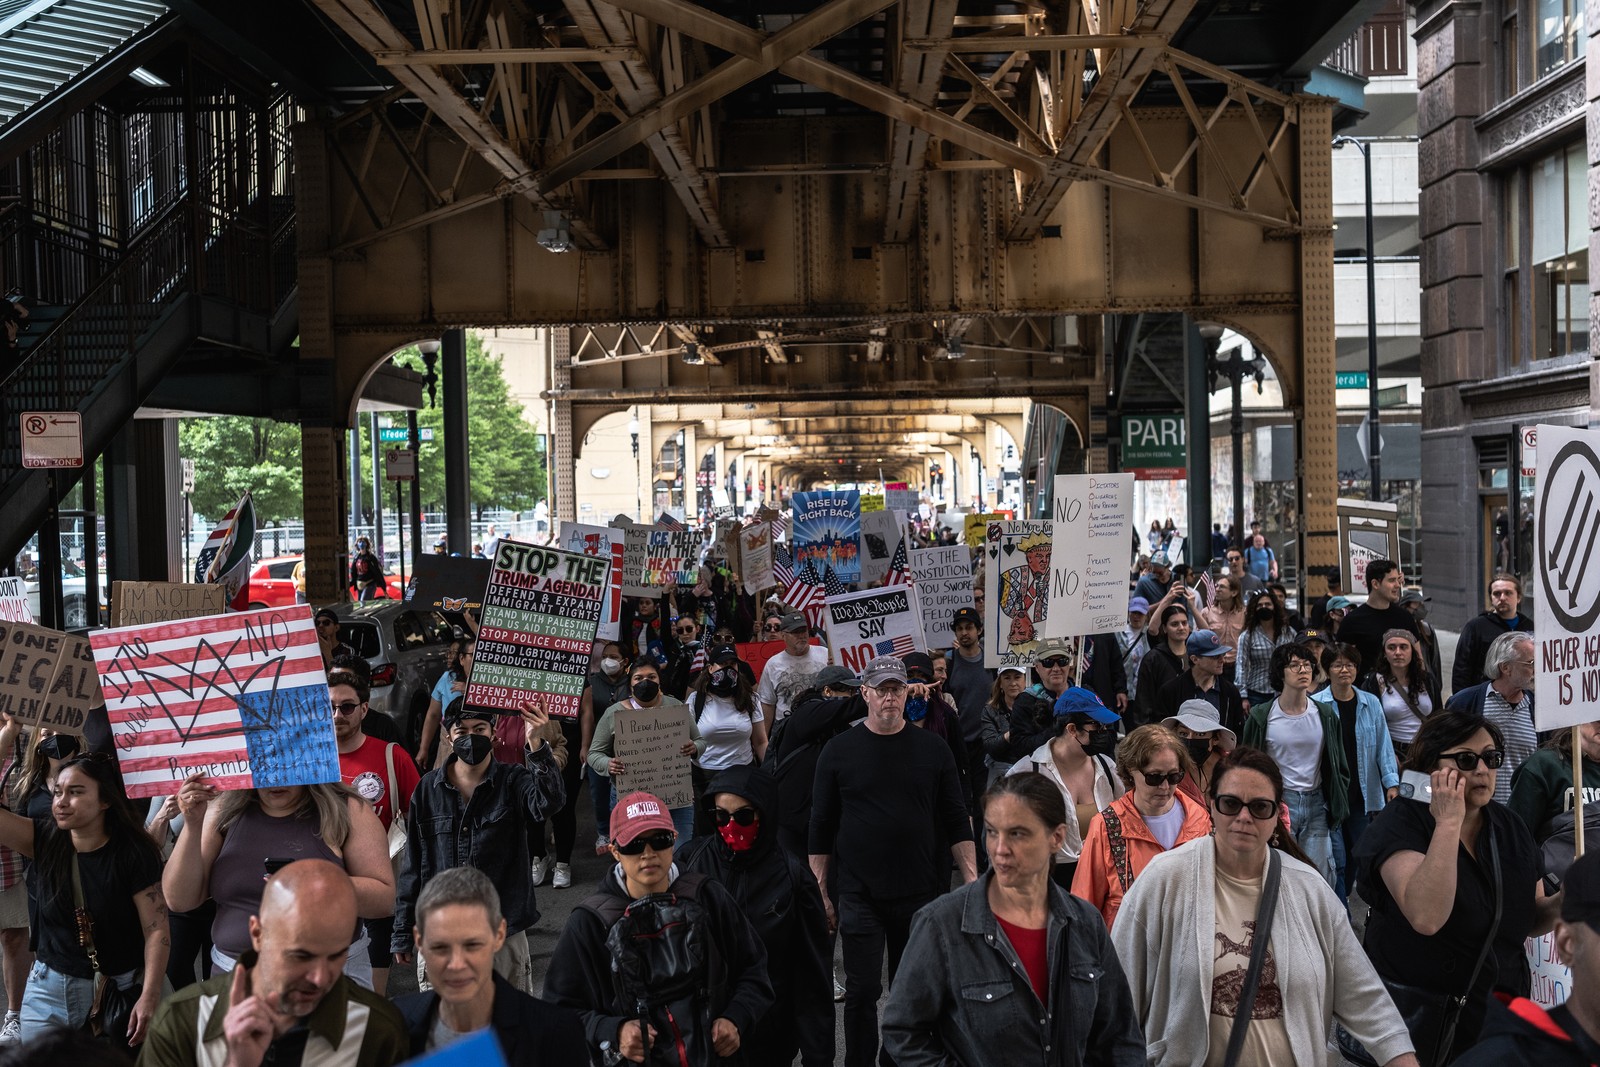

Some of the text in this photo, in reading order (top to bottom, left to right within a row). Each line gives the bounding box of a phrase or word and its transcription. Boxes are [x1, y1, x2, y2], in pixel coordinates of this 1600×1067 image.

[26, 458, 48, 466] TOW
[798, 509, 856, 522] FIGHT BACK
[807, 499, 830, 510] RISE
[1056, 497, 1082, 523] NO
[650, 531, 668, 545] ICE
[671, 530, 704, 545] MELTS
[1008, 522, 1020, 534] No
[1022, 521, 1040, 533] More
[647, 545, 671, 558] WITH
[675, 545, 696, 558] THE
[914, 550, 960, 567] IT'S THE
[498, 544, 606, 584] STOP THE
[648, 558, 682, 570] HEAT
[684, 558, 698, 570] OF
[912, 564, 970, 580] ONSTUTION
[494, 569, 540, 589] TRUMP
[542, 578, 601, 600] AGENDA!
[644, 570, 698, 584] RESISTANCE
[919, 580, 974, 594] YOU SWORE
[1054, 568, 1079, 598] NO
[124, 588, 216, 608] I'M NOT A
[488, 595, 599, 620] IMMIGRANT RIGHTS
[490, 586, 600, 612] DEFEND & EXPAND
[832, 604, 854, 622] We
[868, 594, 908, 617] People
[920, 595, 972, 606] TO UPHOLD
[120, 608, 153, 626] PAID
[484, 616, 503, 626] END
[508, 620, 520, 629] US
[524, 622, 540, 632] AID
[546, 626, 556, 635] TO
[561, 628, 592, 640] ISRAEL
[486, 607, 518, 620] STAND
[521, 612, 544, 624] WITH
[547, 616, 594, 632] PALESTINE
[858, 617, 886, 640] SAY
[12, 630, 59, 654] ONE
[73, 642, 94, 662] IS
[245, 614, 289, 661] NO
[480, 628, 591, 652] STOP POLICE CRIMES
[476, 651, 586, 675] REPRODUCTIVE RIGHTS
[478, 640, 589, 665] DEFEND LGBTQIA+ AND
[840, 642, 875, 674] NO
[1542, 636, 1580, 673] NEVER
[103, 638, 149, 704] 1776
[474, 664, 503, 675] DEFEND
[546, 673, 572, 684] RIGHTS
[574, 676, 584, 686] TO
[469, 684, 508, 698] DEFEND
[572, 697, 579, 706] &
[472, 672, 582, 695] UNIONIZE & STRIKE
[1559, 669, 1600, 706] IS NO
[466, 694, 524, 709] ACADEMIC
[42, 702, 84, 728] LAND
[620, 720, 624, 734] I
[616, 750, 639, 758] UNITED
[642, 746, 662, 754] STATES
[168, 754, 267, 780] Remember
[624, 760, 652, 768] merica
